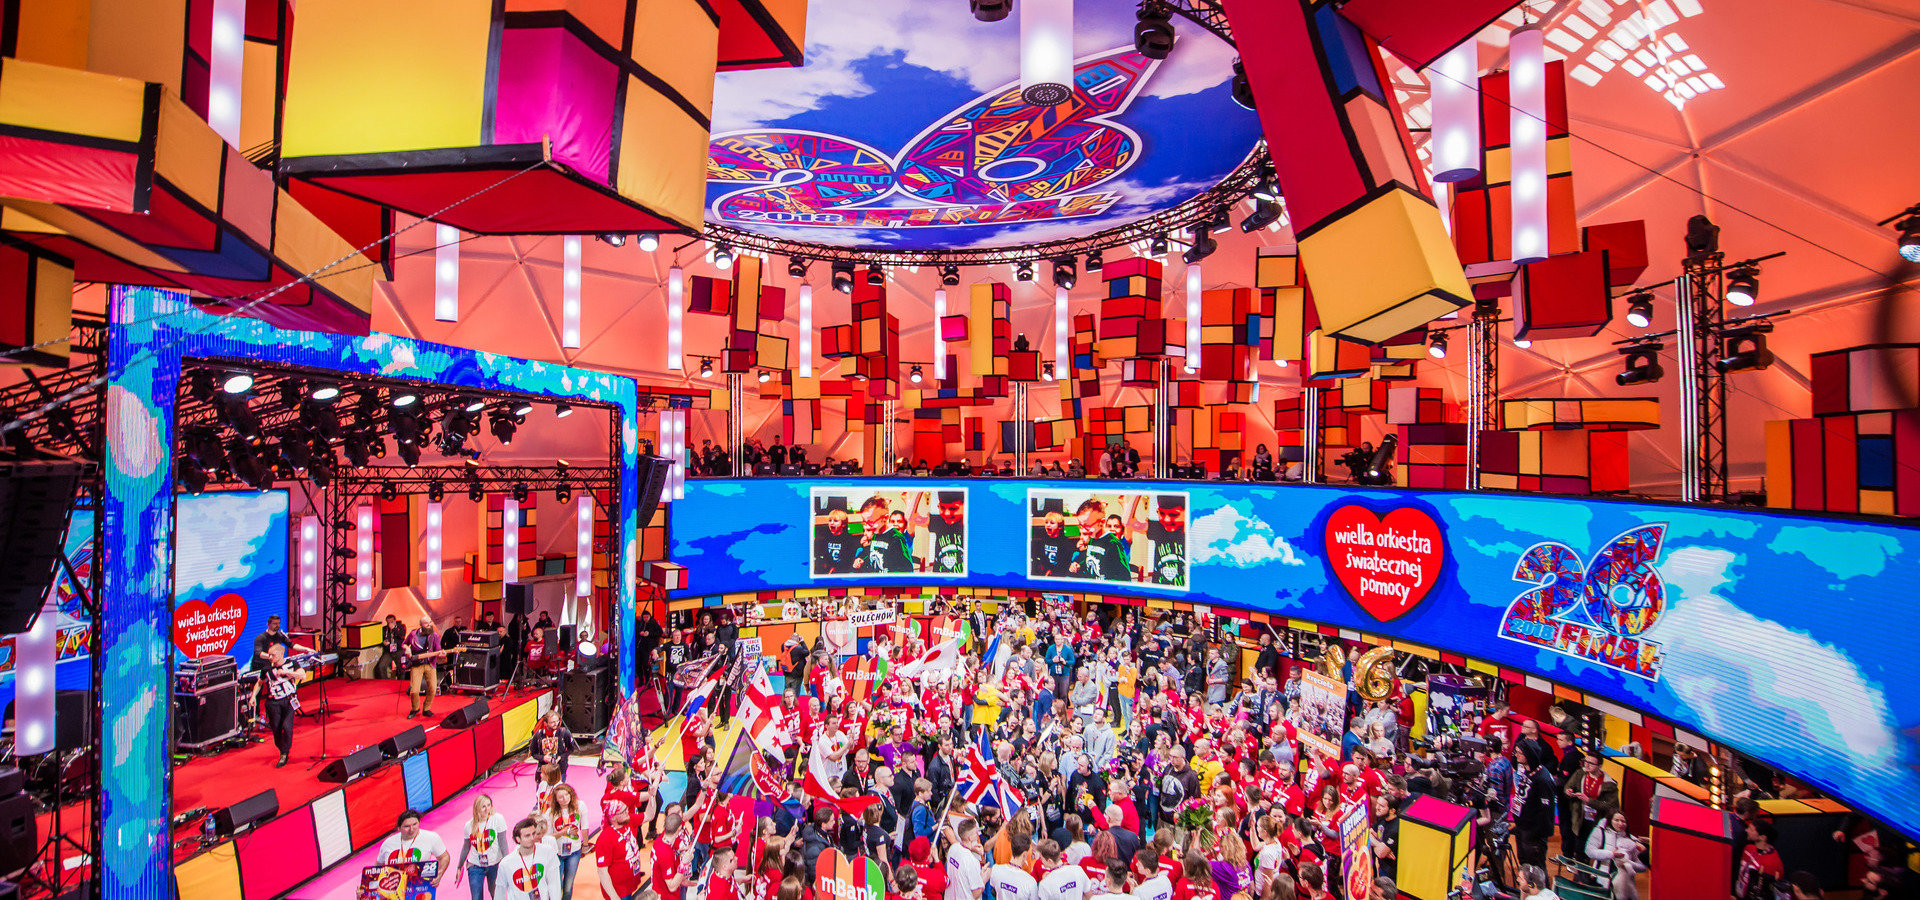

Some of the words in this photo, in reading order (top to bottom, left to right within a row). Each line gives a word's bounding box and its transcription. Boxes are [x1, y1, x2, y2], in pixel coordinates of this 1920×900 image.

[736, 209, 845, 224] 2018
[1334, 523, 1375, 546] wielka
[1376, 527, 1432, 554] orkiestra
[1345, 547, 1423, 588] świątecznej
[1360, 576, 1411, 606] pomocy
[177, 610, 206, 629] wielka
[207, 605, 242, 623] orkiestra
[185, 620, 236, 643] świątecznej
[933, 626, 967, 640] mBank
[1509, 617, 1556, 641] 2018
[195, 639, 229, 658] pomocy
[746, 644, 760, 652] 565
[845, 670, 883, 681] mBank
[821, 876, 878, 900] mBank
